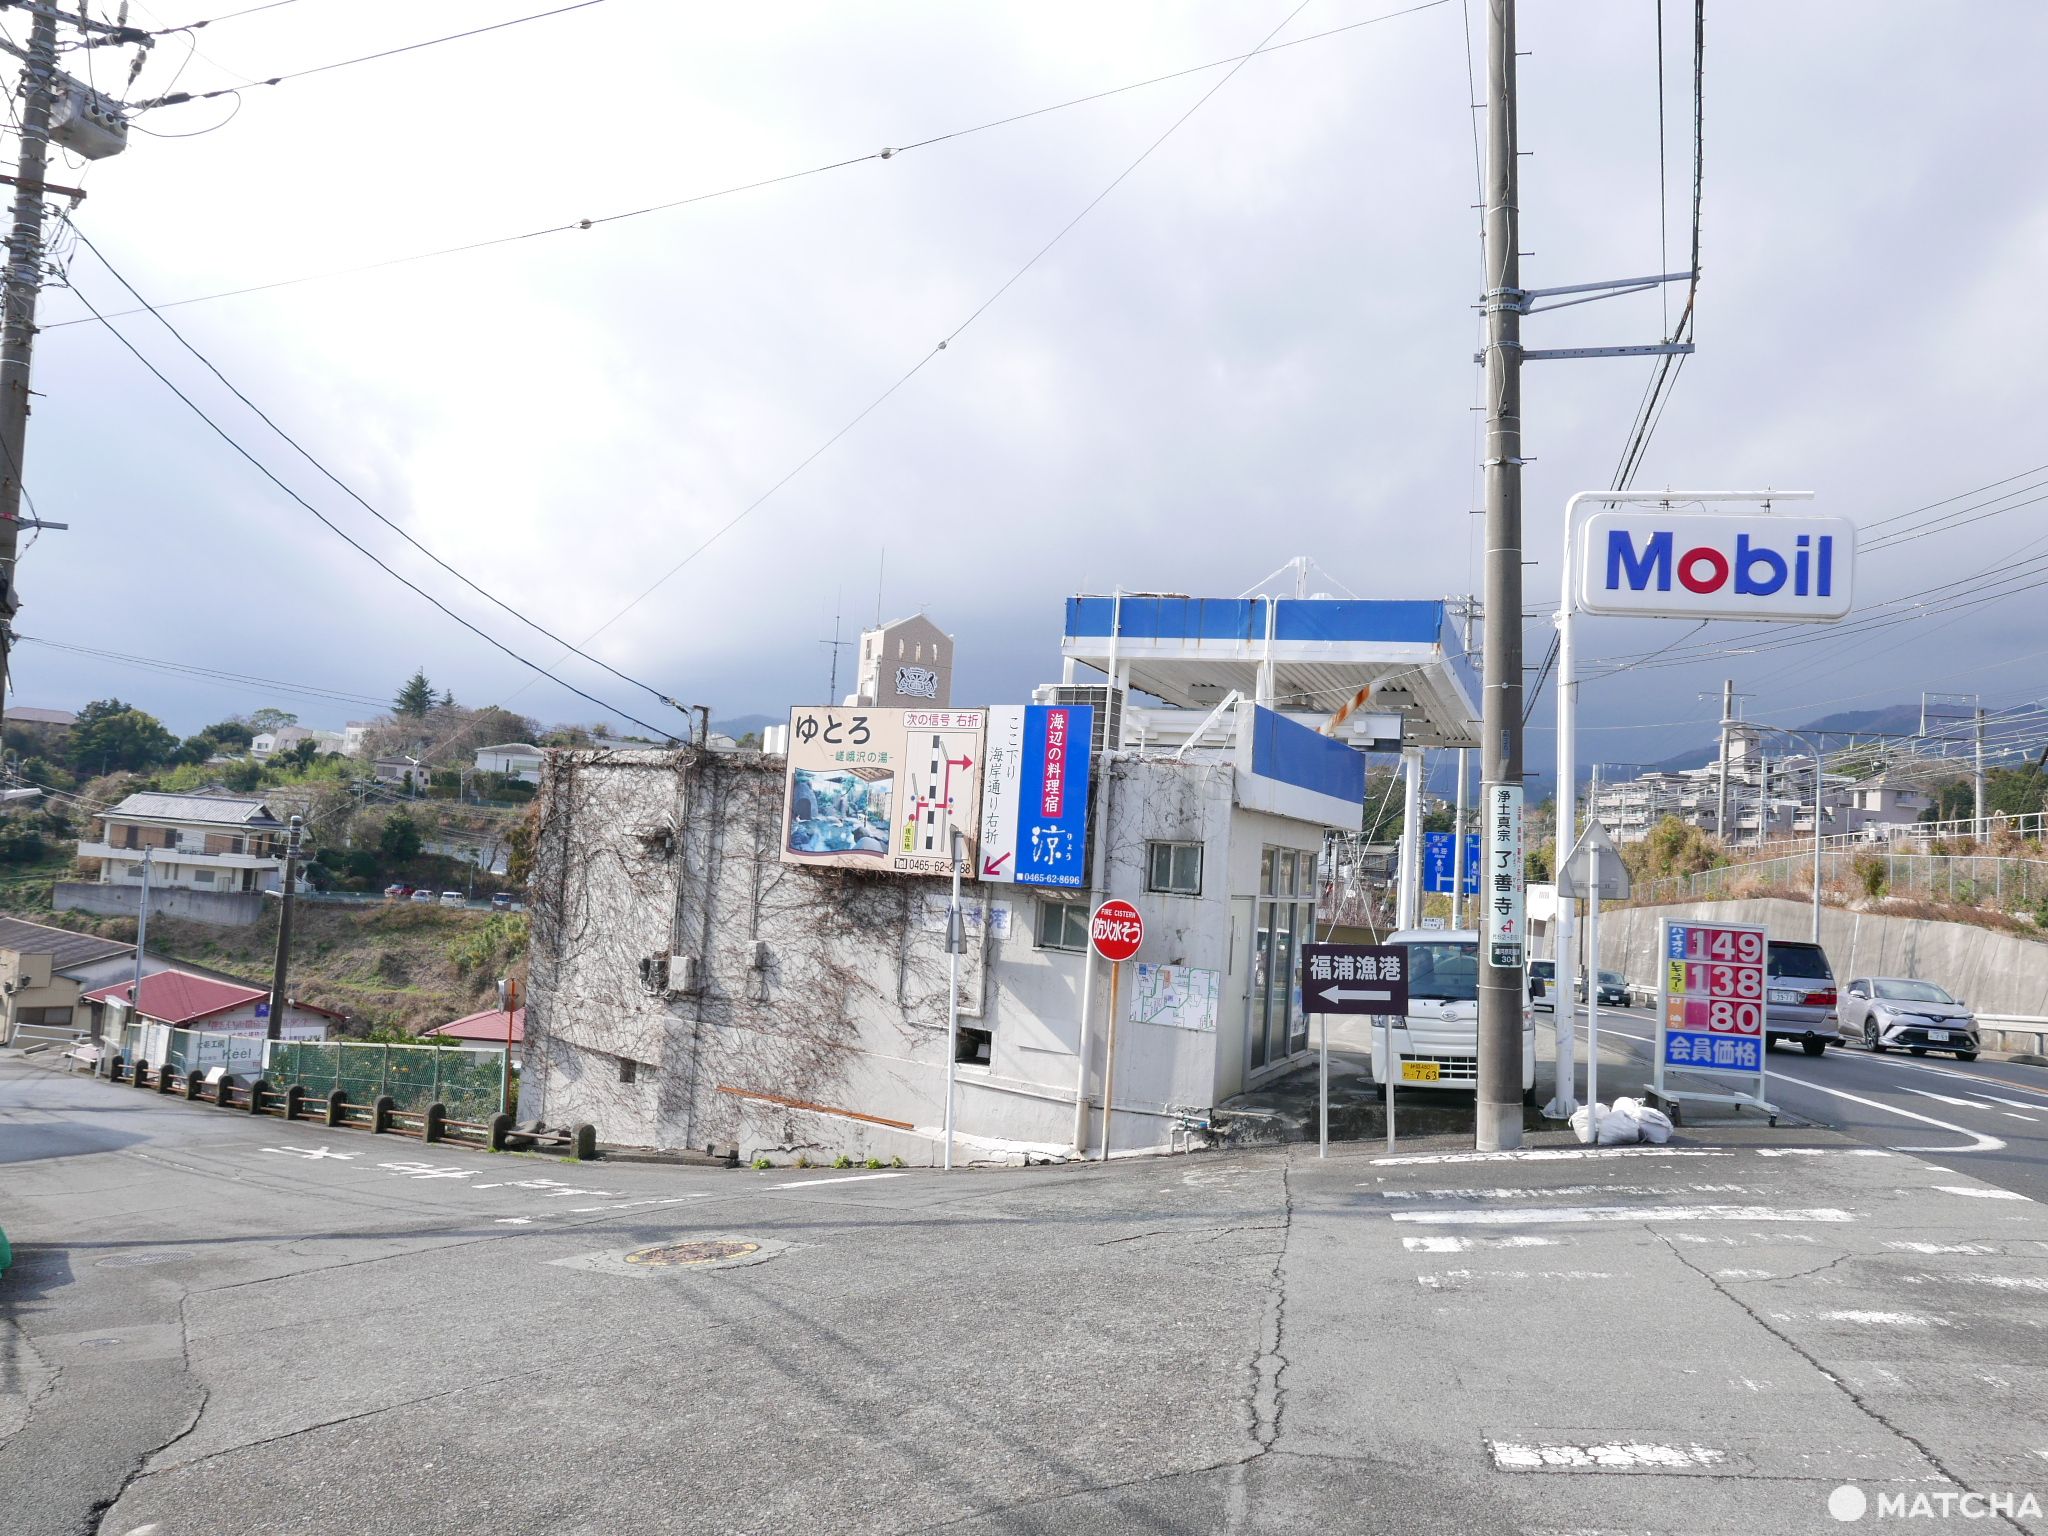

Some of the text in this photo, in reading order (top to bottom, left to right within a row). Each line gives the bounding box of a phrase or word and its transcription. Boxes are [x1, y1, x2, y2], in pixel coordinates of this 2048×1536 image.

[1605, 530, 1833, 597] Mobil
[795, 714, 871, 745] ゆとろ
[907, 713, 979, 728] 次の信号 右折
[1045, 713, 1065, 813] 海辺の料理宿
[985, 746, 1004, 845] 海岸通り右折
[1497, 790, 1511, 842] 浄土真宗
[1031, 824, 1066, 865] 涼
[910, 859, 971, 874] 0465-62-288
[1024, 873, 1080, 885] 0465-62-8696
[1494, 851, 1513, 916] 了善寺
[1101, 908, 1136, 918] FIRE CISTERN
[1093, 917, 1141, 943] 防火水そう
[1692, 930, 1762, 963] 149
[1310, 954, 1400, 980] 福浦漁港
[1691, 965, 1761, 998] 138
[1710, 1001, 1760, 1033] 80
[1669, 1035, 1757, 1067] 会員価格
